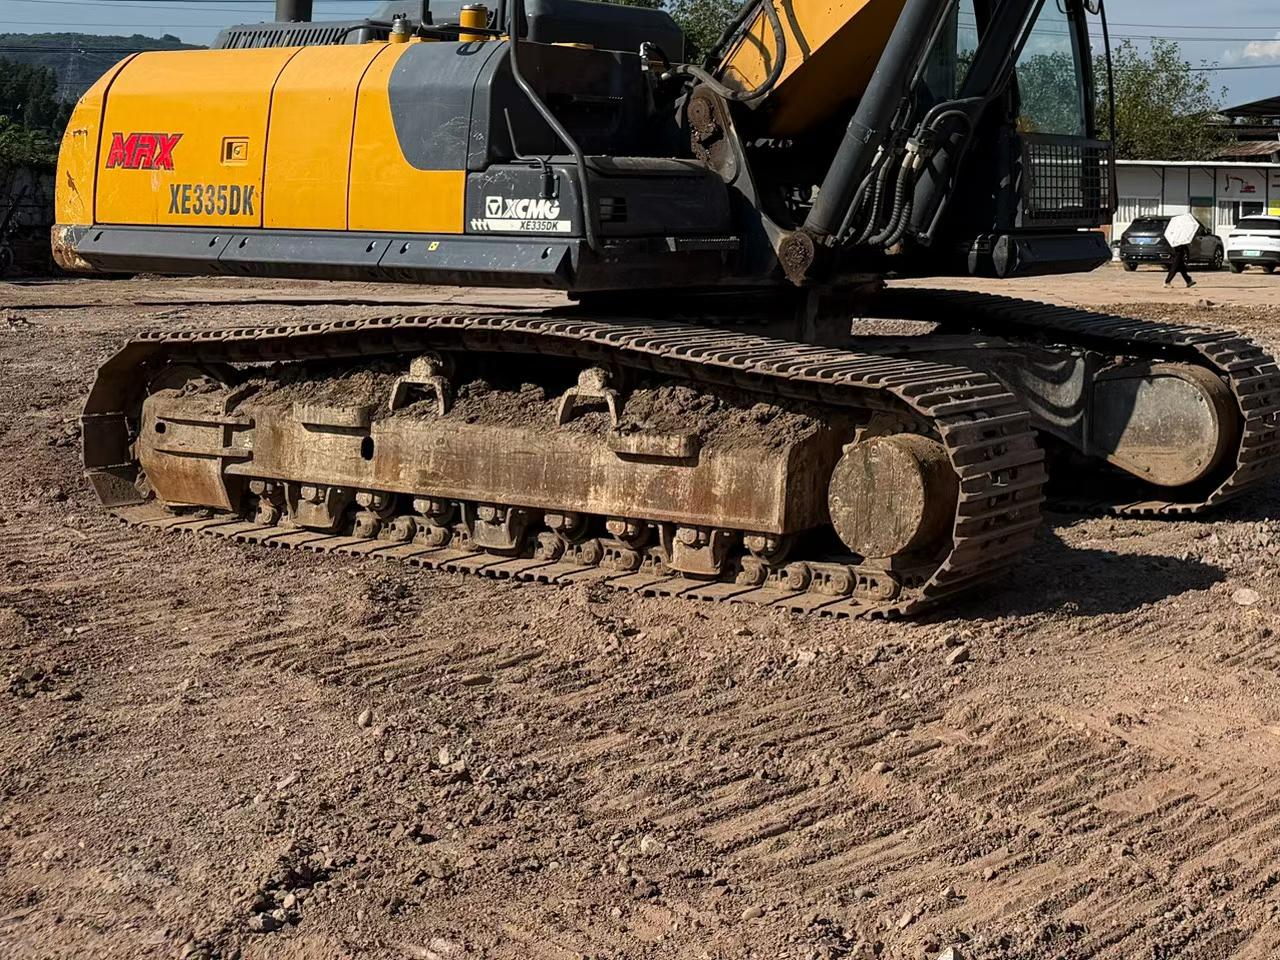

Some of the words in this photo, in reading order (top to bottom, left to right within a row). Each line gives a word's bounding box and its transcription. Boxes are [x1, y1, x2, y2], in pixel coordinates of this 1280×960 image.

[168, 184, 255, 215] XE335DK
[502, 199, 560, 219] XCMG
[520, 220, 558, 231] XE335DK
